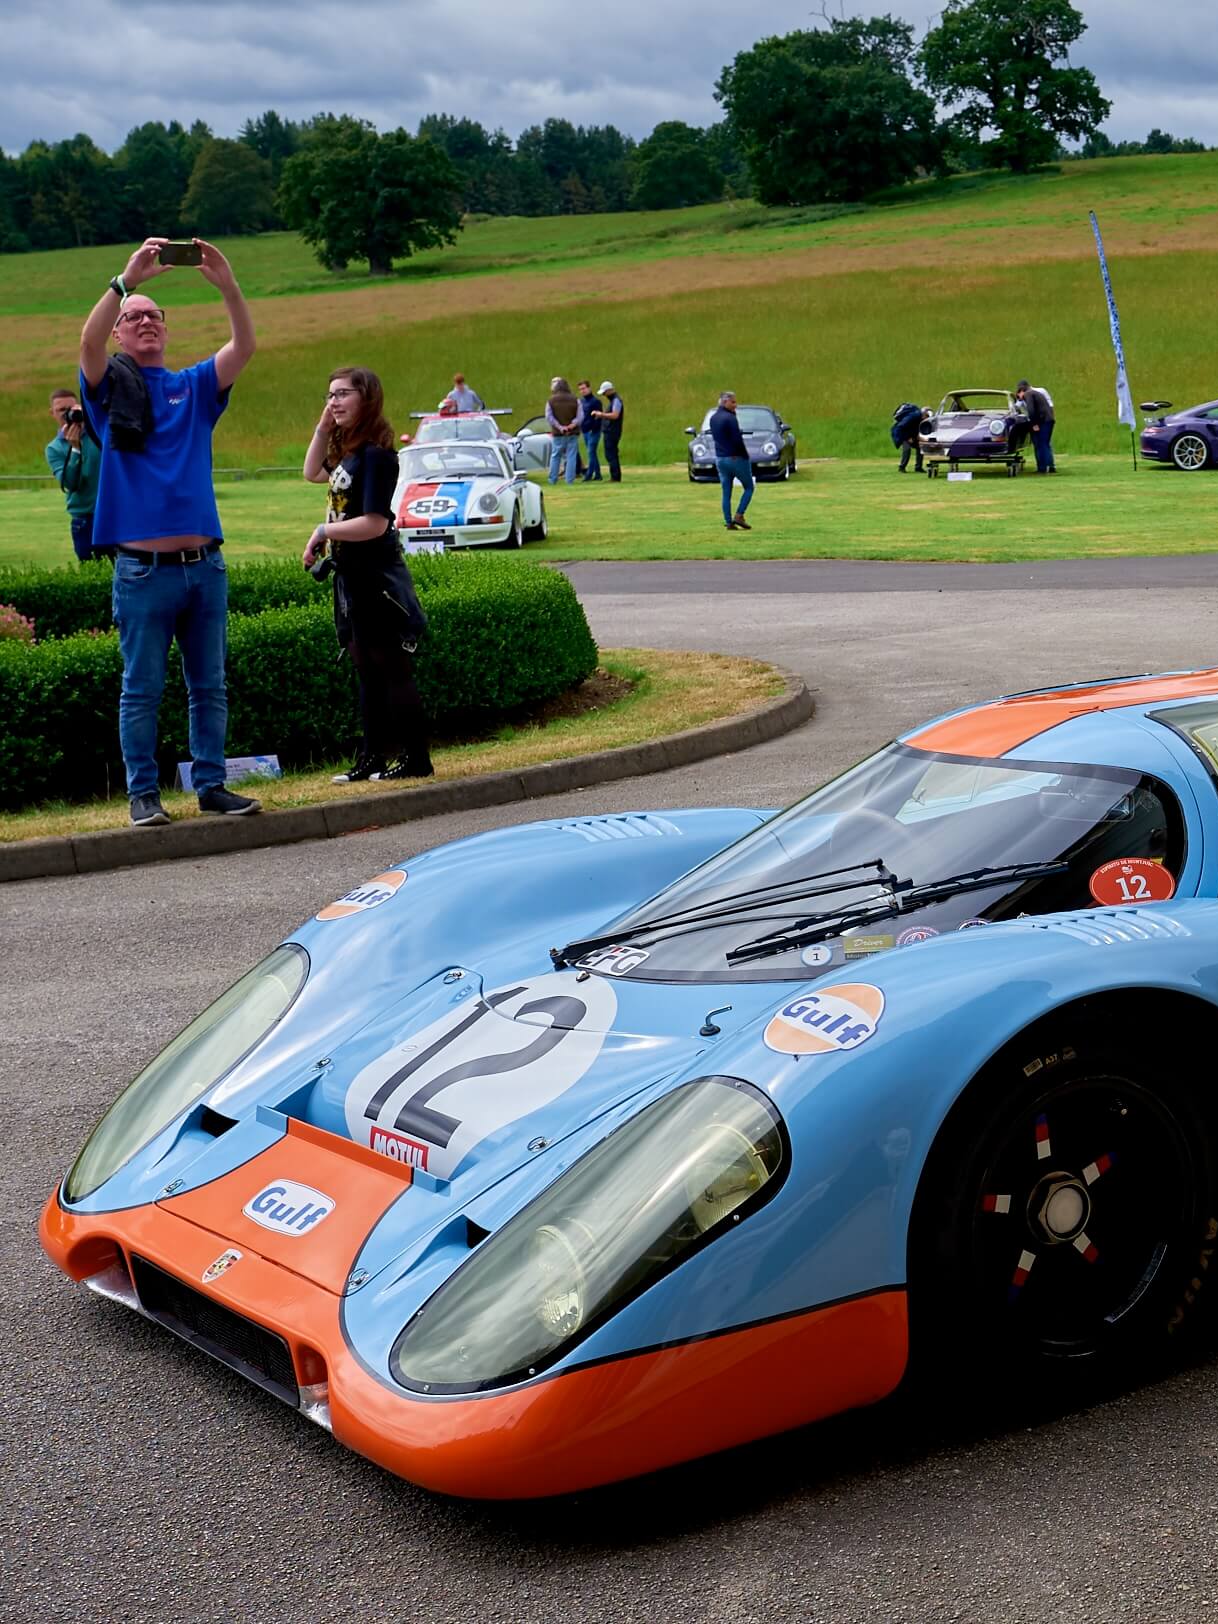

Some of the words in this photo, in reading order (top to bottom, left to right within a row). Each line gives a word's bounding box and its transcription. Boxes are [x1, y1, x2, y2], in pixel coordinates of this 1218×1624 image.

[415, 499, 449, 514] 59
[1115, 875, 1152, 900] 12
[812, 952, 820, 961] 1
[853, 938, 884, 947] Driver
[782, 996, 870, 1044] Gulf
[364, 986, 587, 1149] 12
[373, 1132, 427, 1172] MOTUL
[251, 1186, 328, 1230] Gulf
